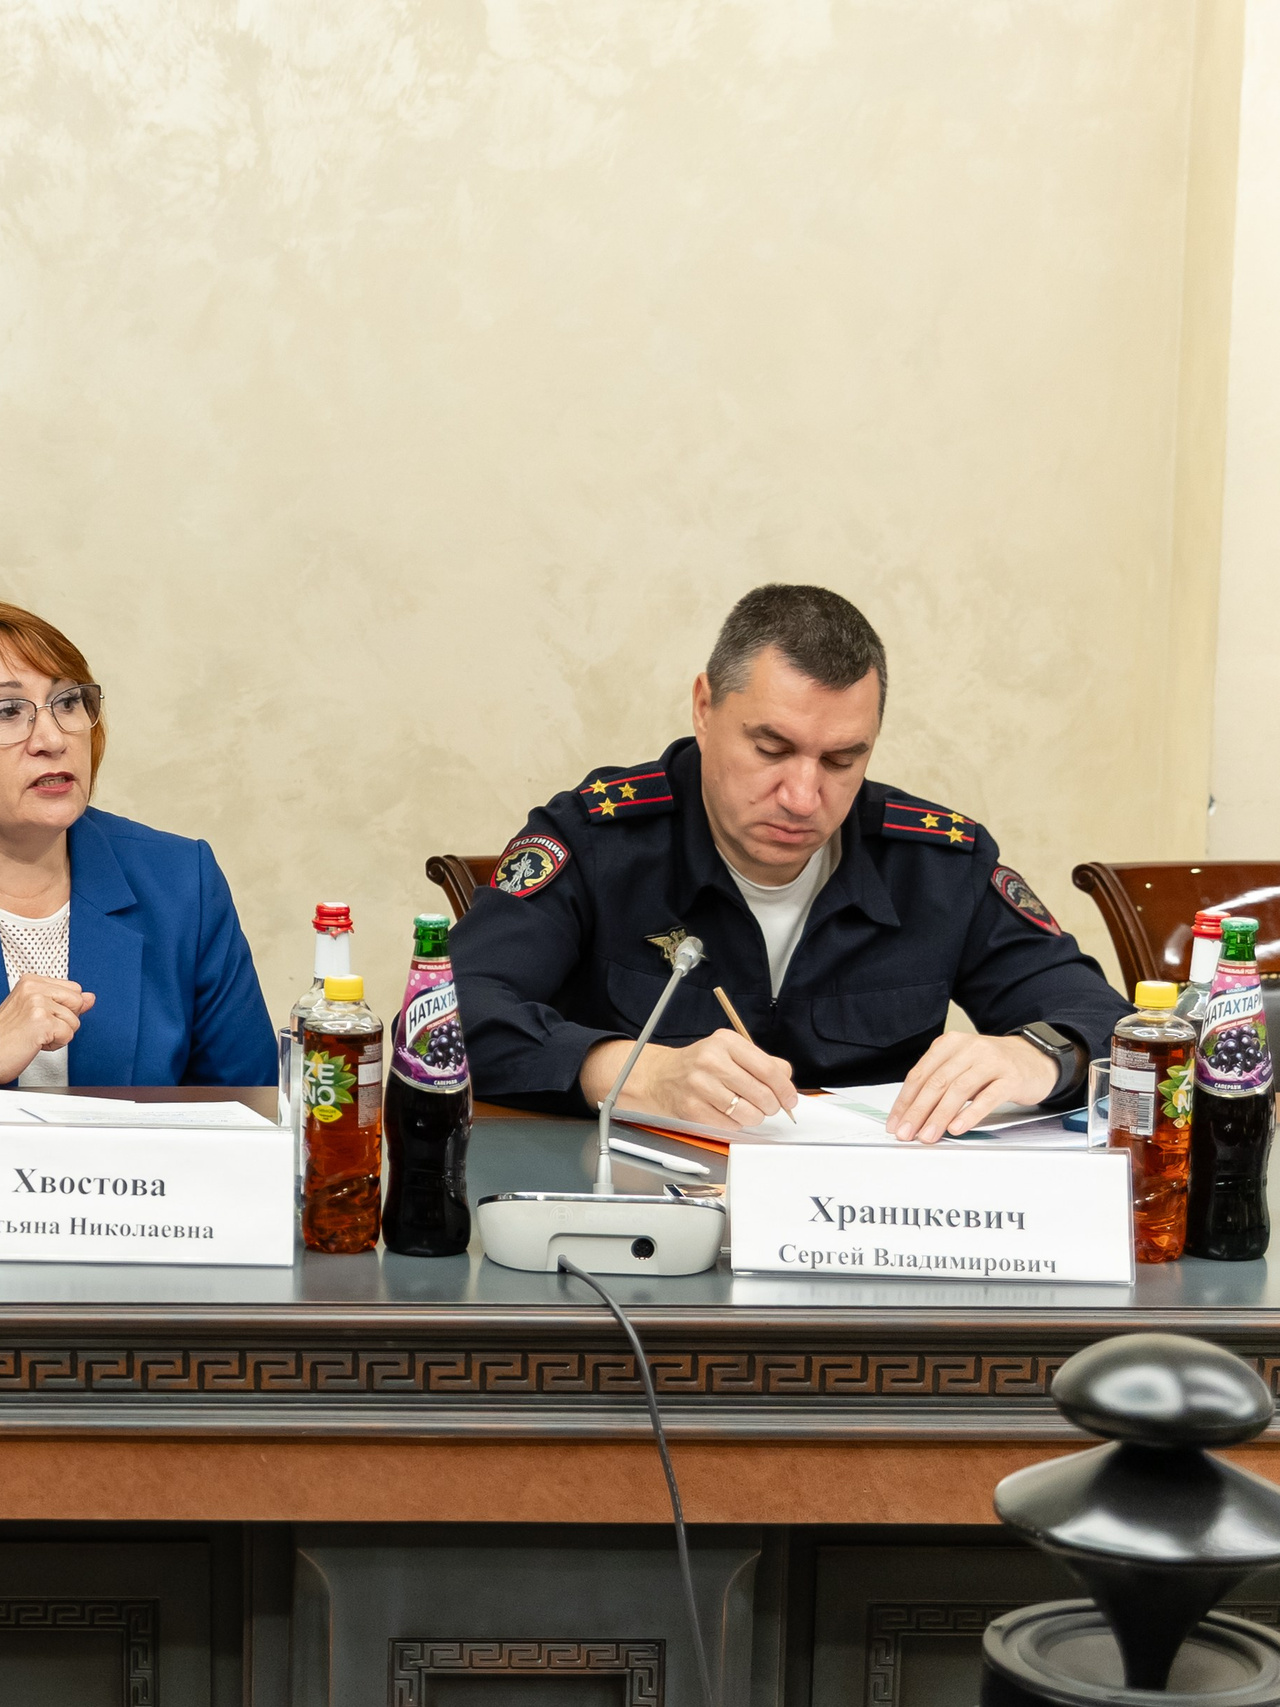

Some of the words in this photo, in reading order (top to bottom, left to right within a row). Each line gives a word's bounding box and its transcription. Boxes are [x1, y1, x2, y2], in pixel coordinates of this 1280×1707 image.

[511, 837, 565, 861] ПОЛИЦИЯ
[11, 1168, 167, 1197] Хвостова
[69, 1216, 215, 1239] Николаевна
[808, 1195, 1026, 1231] Хранцкевич
[778, 1243, 864, 1270] Сергей
[873, 1247, 1057, 1276] Владимирович
